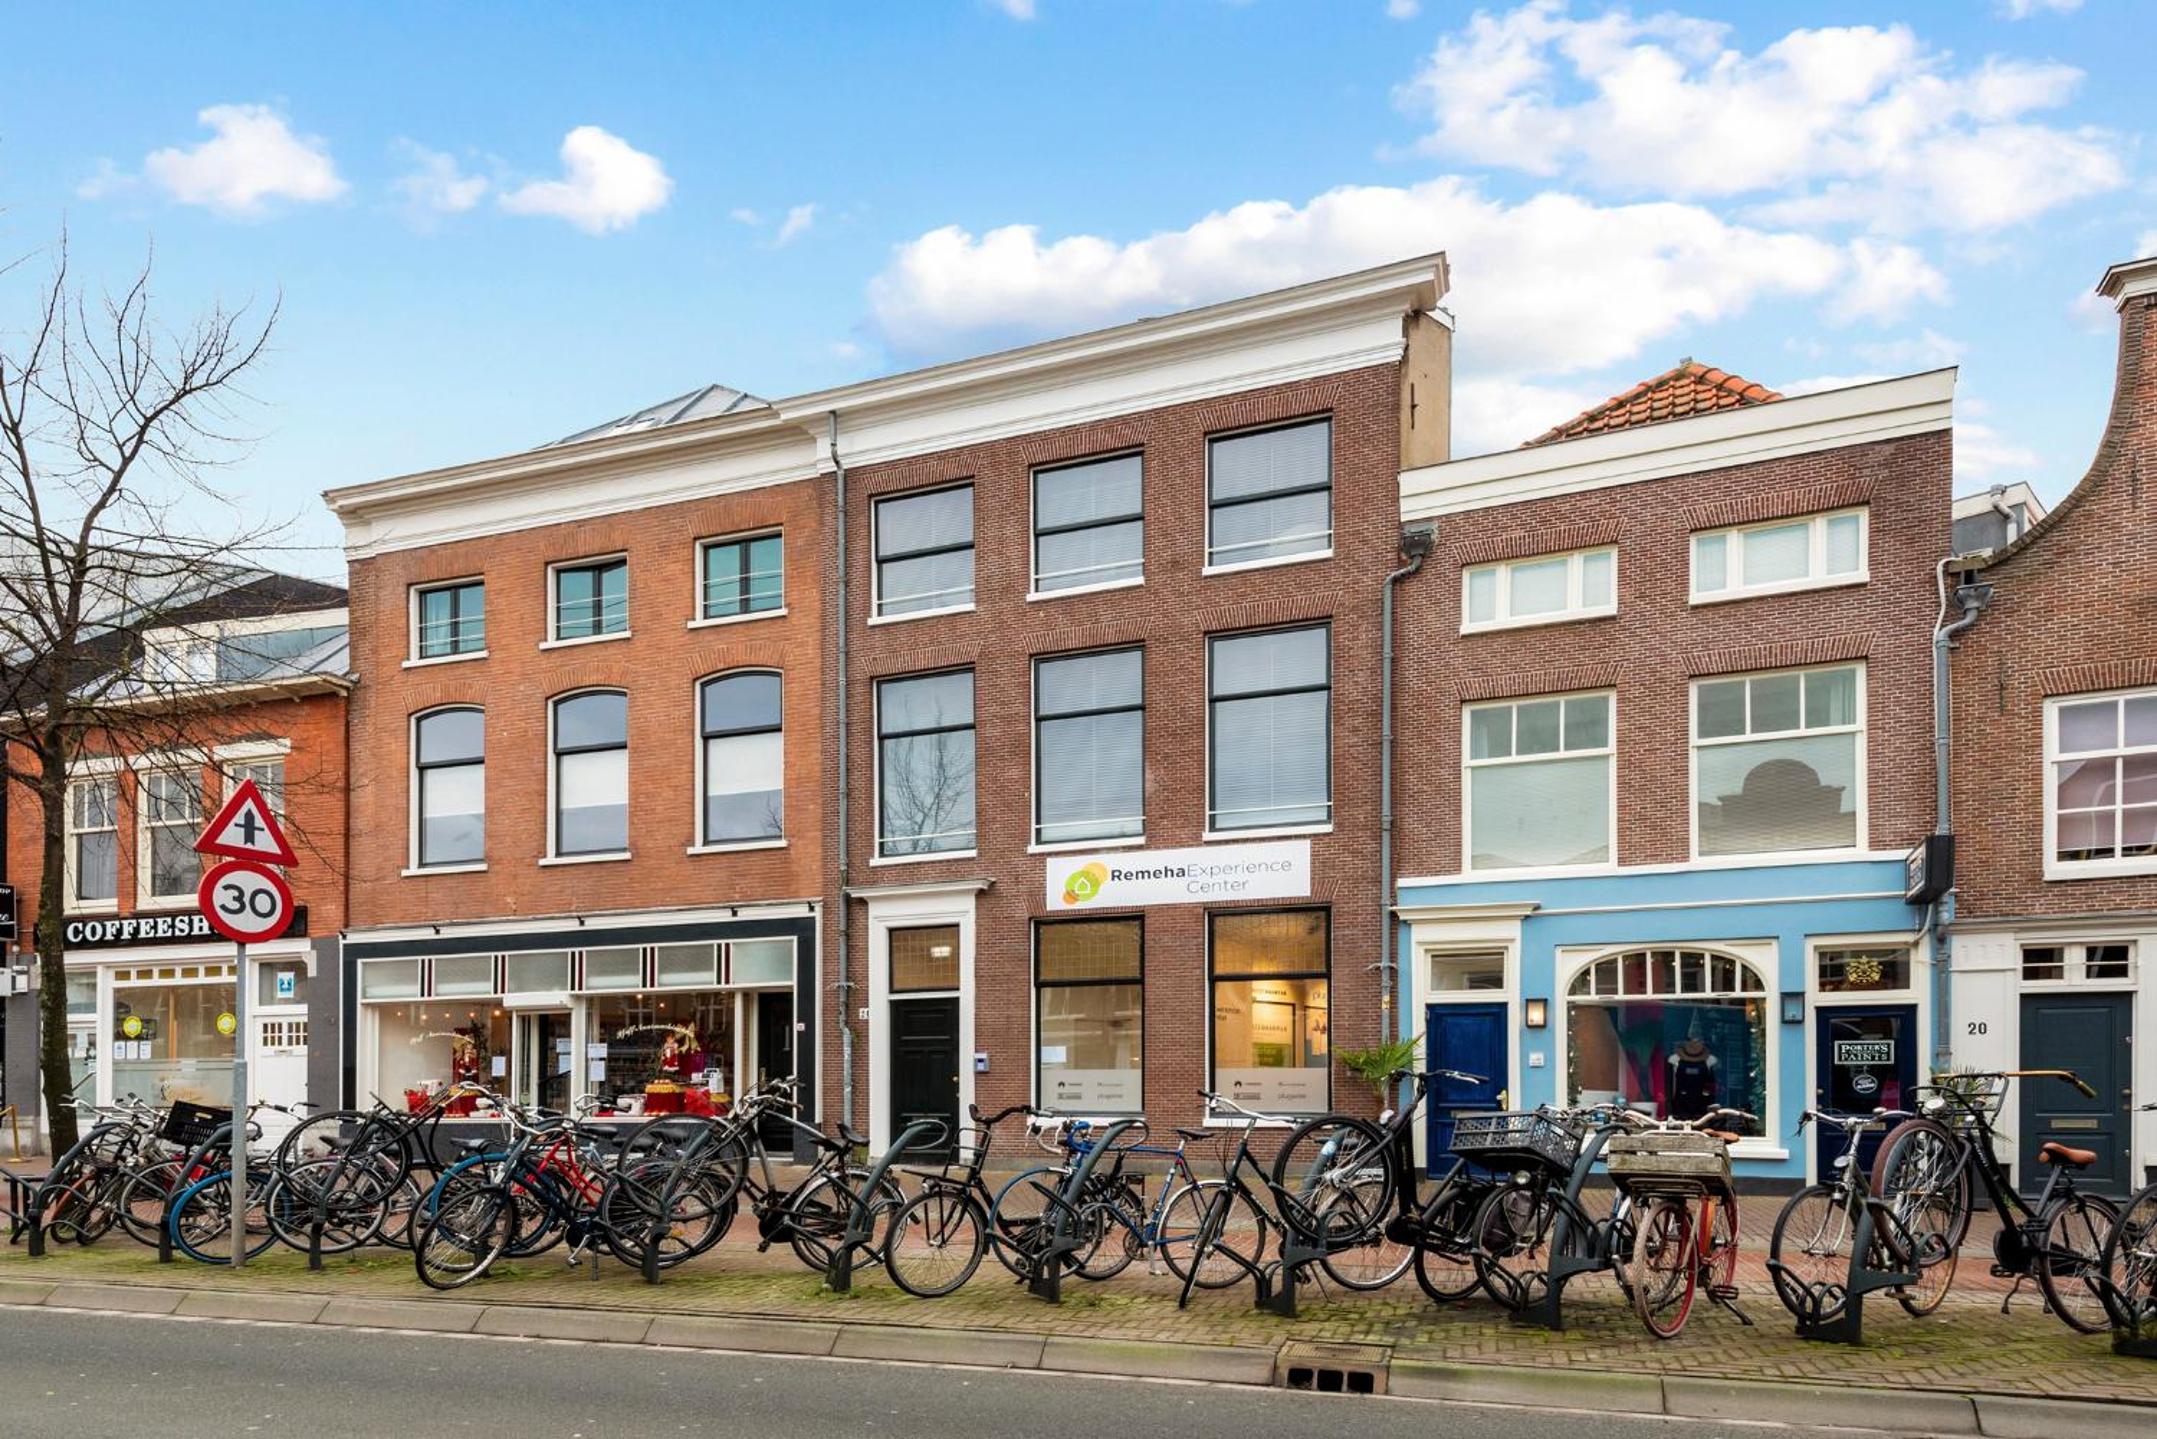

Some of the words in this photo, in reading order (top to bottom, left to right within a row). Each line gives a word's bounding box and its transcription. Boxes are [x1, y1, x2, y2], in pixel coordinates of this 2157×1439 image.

[1187, 879, 1249, 894] Center
[218, 883, 277, 919] 30
[66, 914, 220, 943] COFFEESH
[1968, 1021, 1987, 1035] 20
[1841, 1053, 1888, 1061] PAINTS
